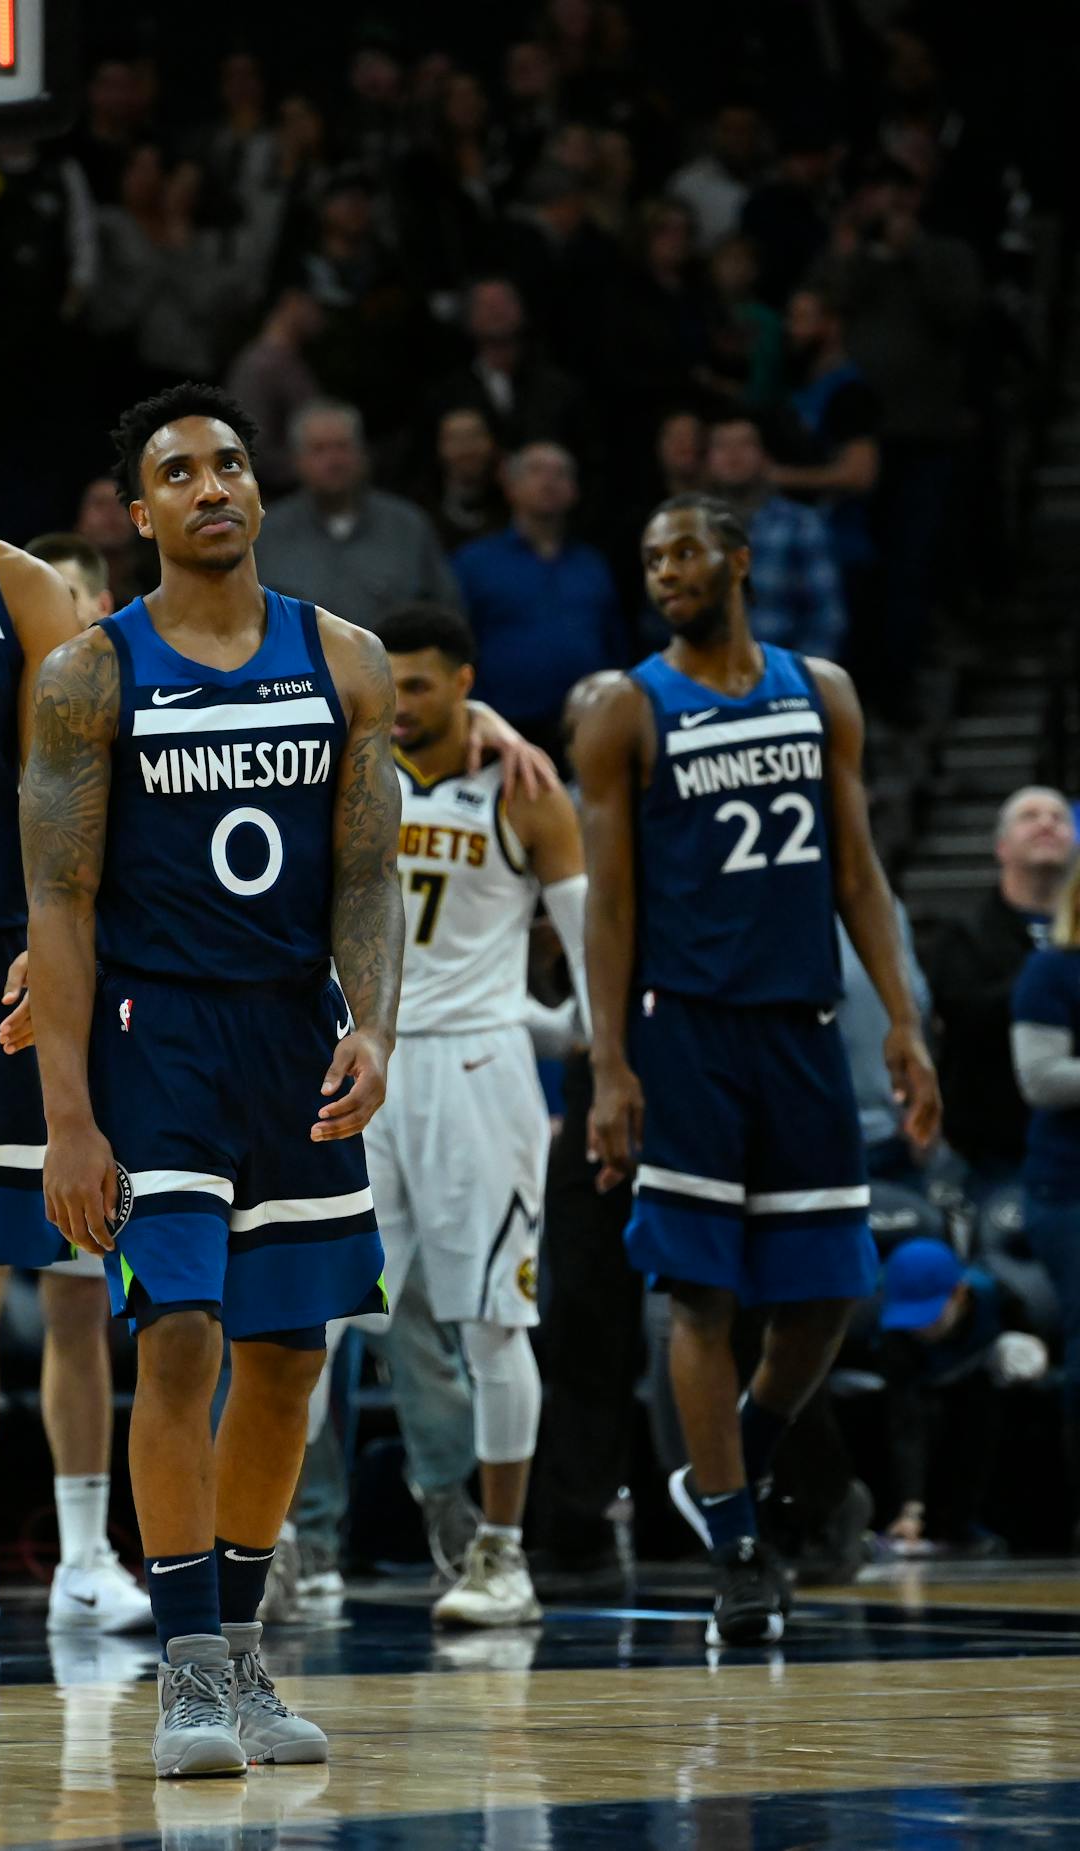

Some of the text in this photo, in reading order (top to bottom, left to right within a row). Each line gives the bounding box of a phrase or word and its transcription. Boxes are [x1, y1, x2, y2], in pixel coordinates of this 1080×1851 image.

[273, 680, 314, 696] fitbit
[140, 740, 331, 794] MINNESOTA
[672, 742, 822, 800] MINNESOTA
[211, 806, 283, 896] 0
[399, 822, 488, 869] GETS
[714, 792, 821, 874] 22
[400, 869, 448, 947] 7
